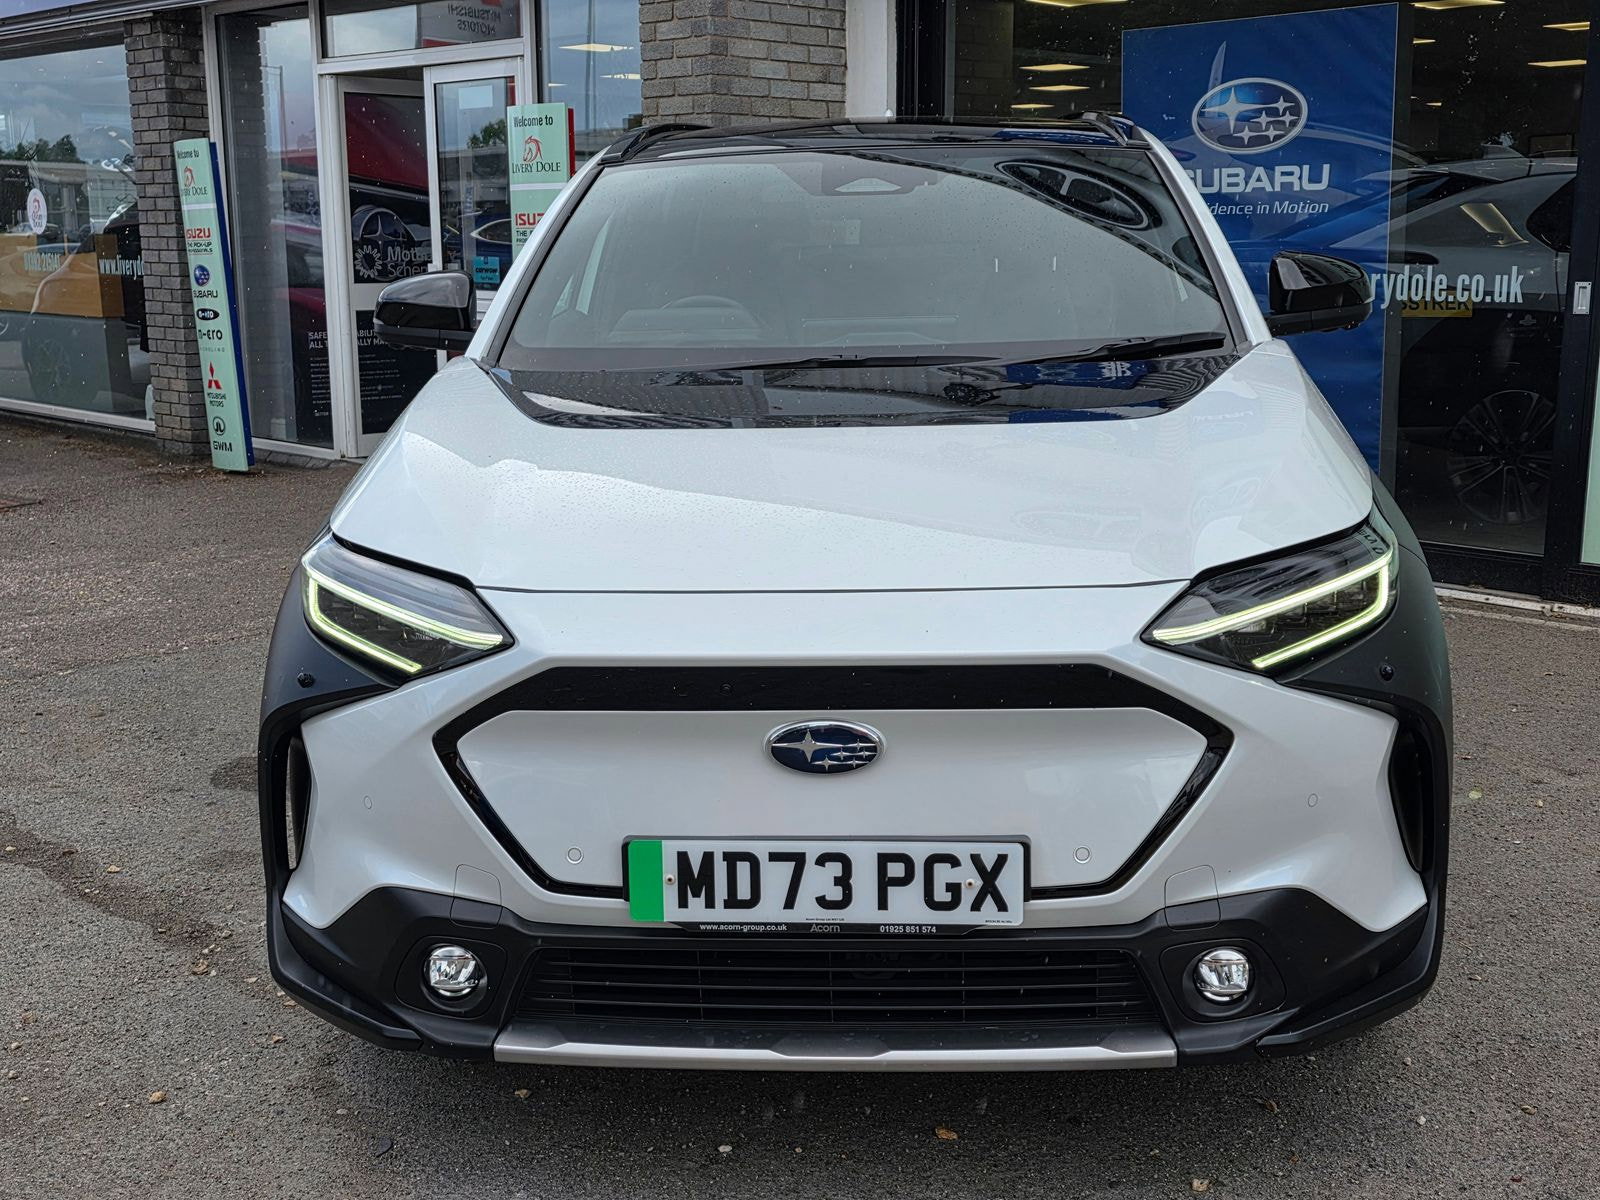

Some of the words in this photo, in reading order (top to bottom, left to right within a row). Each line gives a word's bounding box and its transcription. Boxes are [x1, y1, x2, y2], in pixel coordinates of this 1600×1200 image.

[513, 115, 543, 128] Welcome
[545, 114, 554, 126] to
[511, 162, 534, 174] LIVERY
[536, 161, 561, 173] DOLE
[1207, 203, 1252, 215] idence
[1257, 202, 1269, 214] in
[1273, 200, 1329, 214] Motion
[1370, 265, 1524, 309] rydole.co.uk
[309, 340, 324, 349] ALL
[677, 851, 853, 910] MD73
[877, 853, 1009, 912] PGX
[699, 923, 788, 932] www.acorn-group.co.uk
[810, 923, 841, 933] Acorn
[879, 924, 904, 933] 01925
[905, 925, 920, 933] 851
[922, 925, 937, 934] 574
